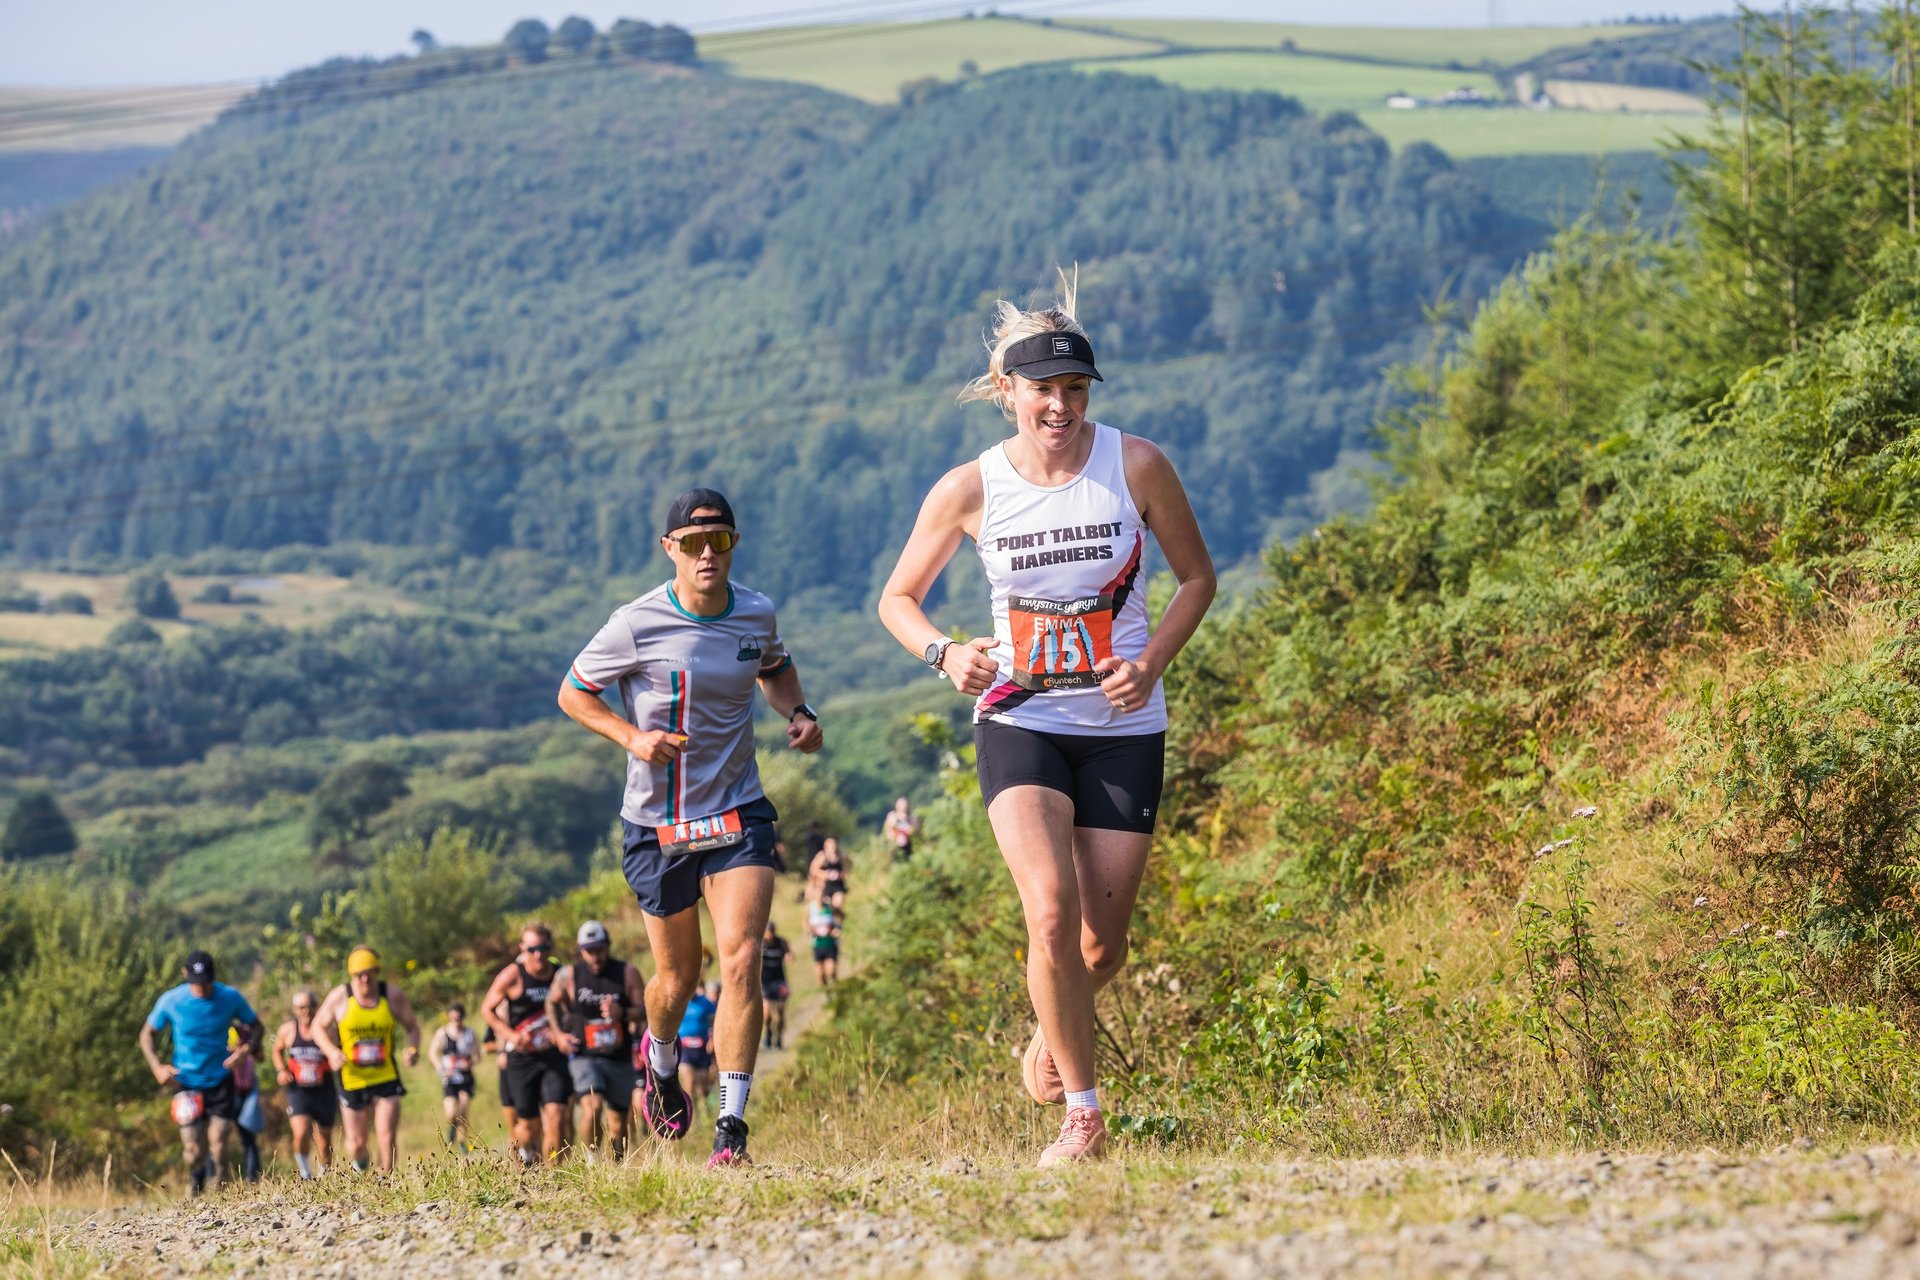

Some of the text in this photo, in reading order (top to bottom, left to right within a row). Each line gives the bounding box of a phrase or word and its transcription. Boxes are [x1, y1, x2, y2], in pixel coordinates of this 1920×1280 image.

[996, 522, 1122, 552] PORT TALBOT
[1010, 544, 1114, 571] HARRIERS
[1033, 616, 1086, 632] EMMA
[1048, 675, 1082, 685] Runtech
